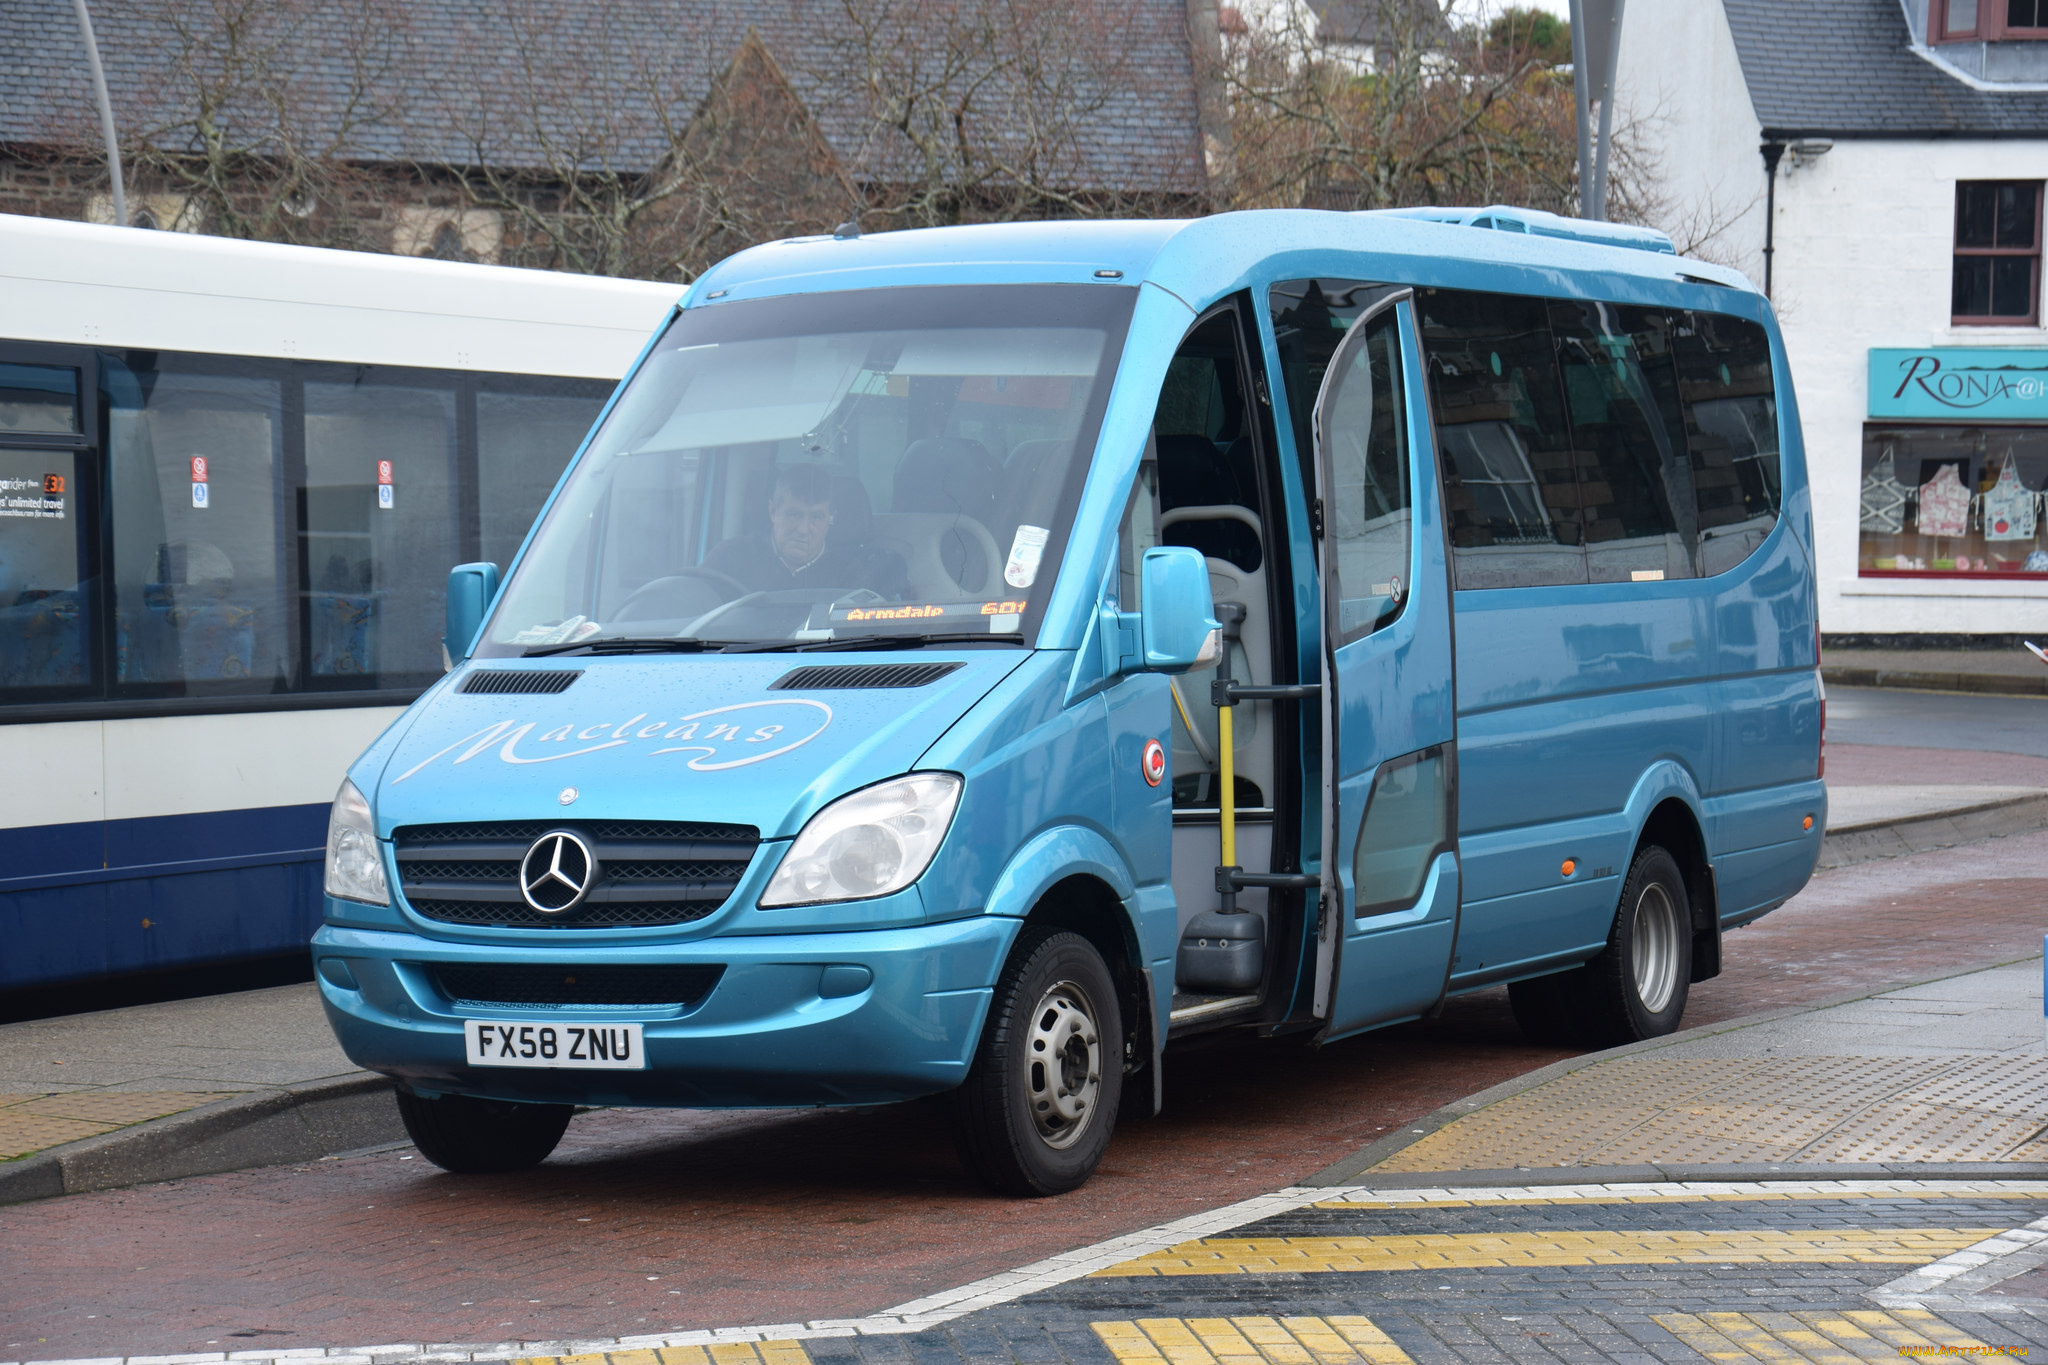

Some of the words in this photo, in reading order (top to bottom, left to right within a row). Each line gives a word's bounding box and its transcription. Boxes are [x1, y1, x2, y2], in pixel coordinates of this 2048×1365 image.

[0, 477, 27, 493] arider
[43, 475, 65, 492] £32
[8, 496, 42, 509] unlimited
[43, 498, 64, 509] travel
[391, 710, 788, 786] Macleans
[478, 1025, 558, 1060] FX58
[567, 1028, 630, 1061] ZNU
